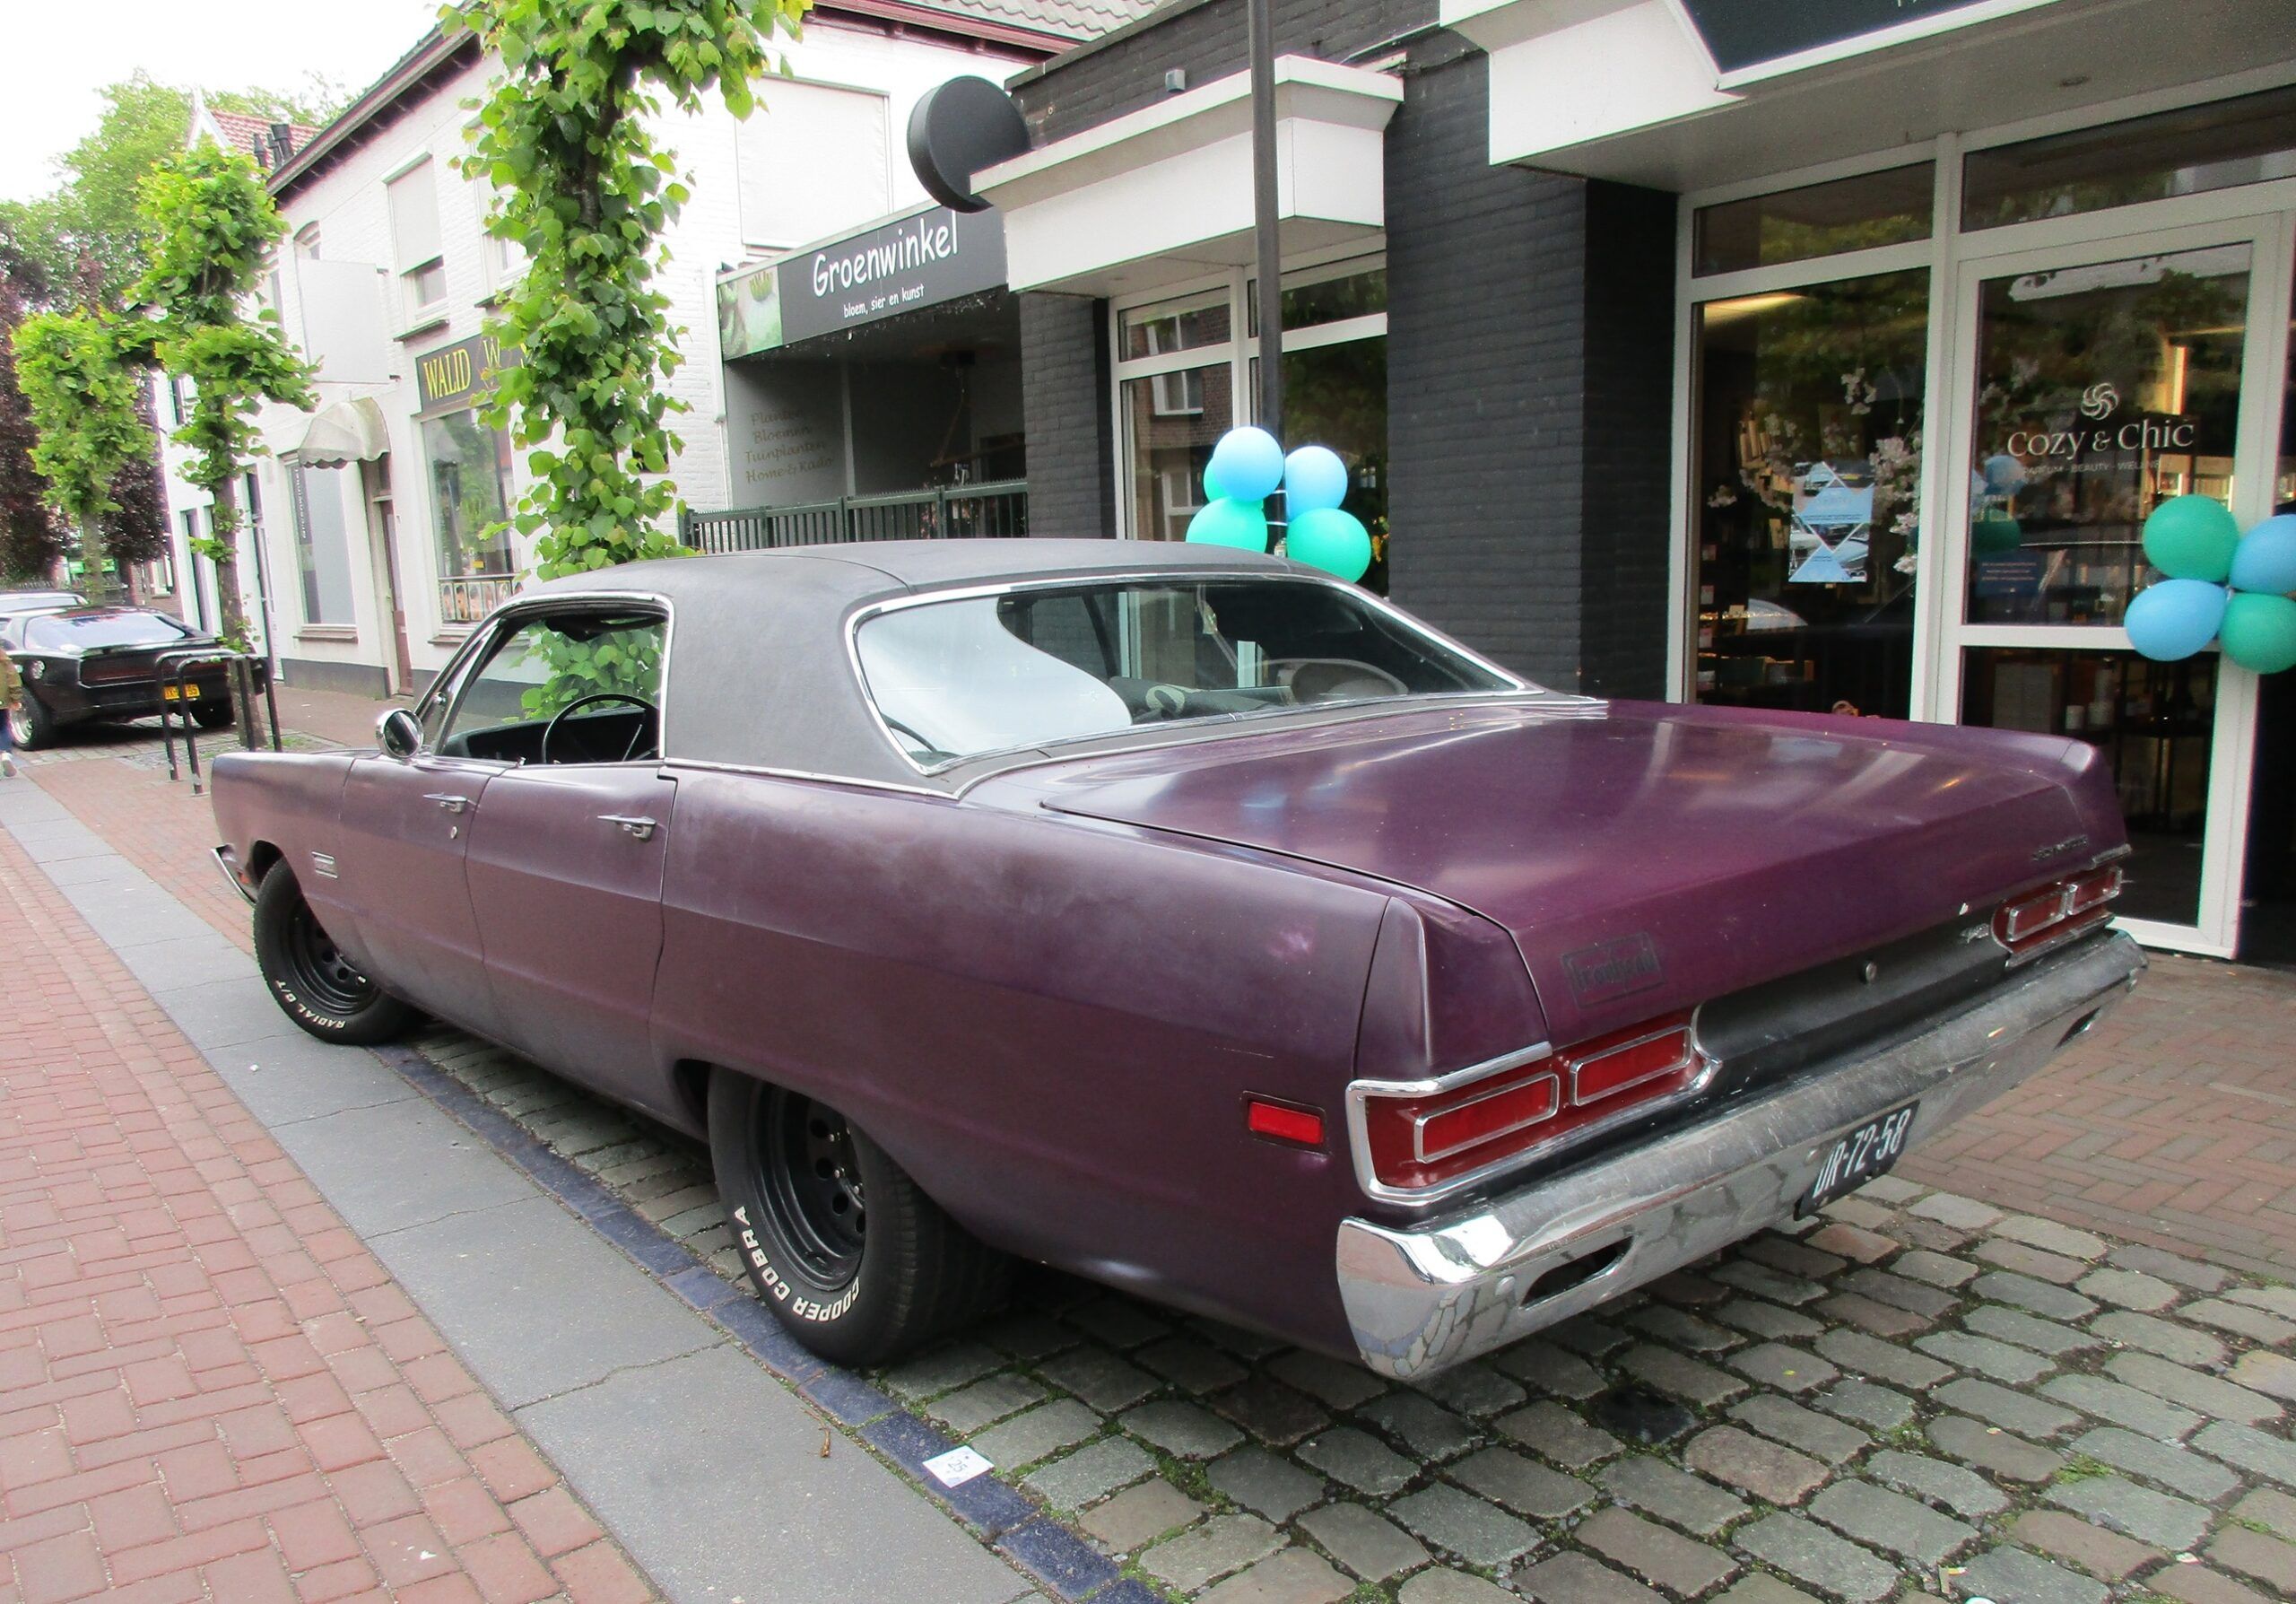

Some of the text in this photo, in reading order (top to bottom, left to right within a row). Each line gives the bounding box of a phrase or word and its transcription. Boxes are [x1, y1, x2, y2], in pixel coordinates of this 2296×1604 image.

[813, 210, 958, 297] Groenwinkel
[844, 283, 925, 318] bloem, sier en kunst
[423, 348, 471, 401] WALID
[2007, 419, 2195, 460] Cozy & Chic
[745, 469, 784, 484] Home
[2071, 462, 2109, 473] BEAUTY
[299, 1003, 346, 1029] RADIAL
[735, 1206, 859, 1321] COOPER COBRA
